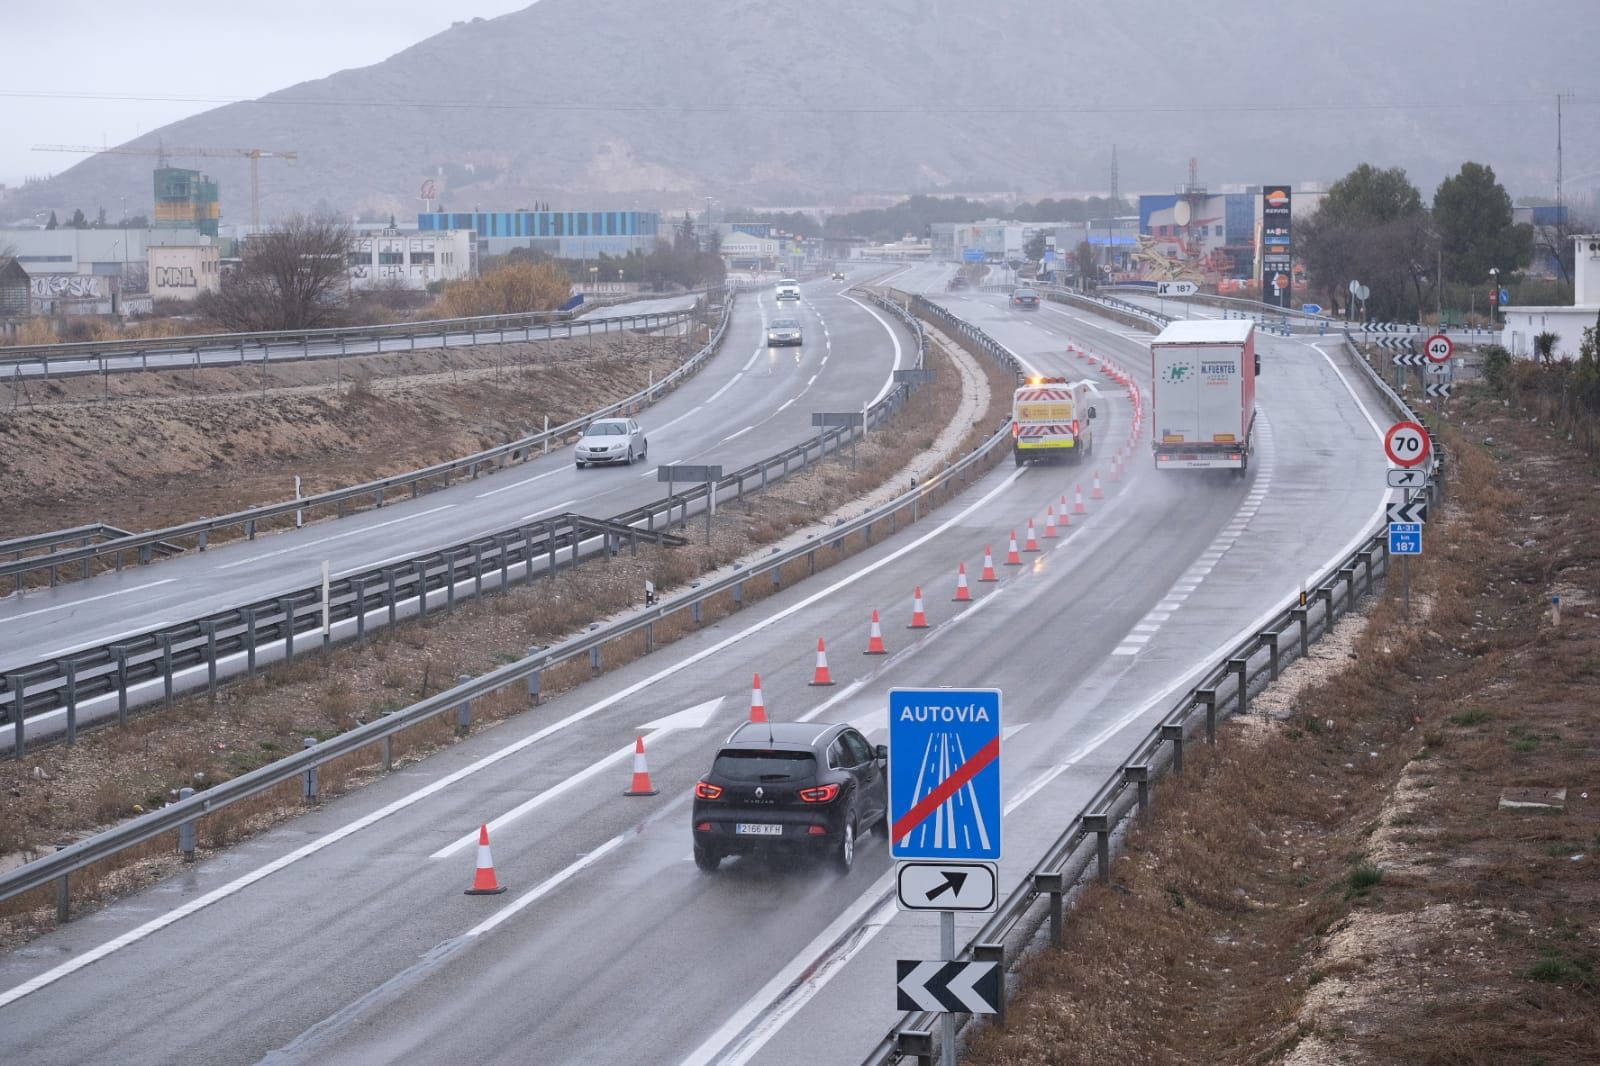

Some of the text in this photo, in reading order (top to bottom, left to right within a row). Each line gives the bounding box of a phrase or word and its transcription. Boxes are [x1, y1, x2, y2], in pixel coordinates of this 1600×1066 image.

[1431, 344, 1447, 353] 40
[1395, 437, 1419, 452] 70
[1396, 542, 1415, 552] 187
[900, 703, 990, 722] AUTOVÍA
[742, 824, 761, 833] 2166
